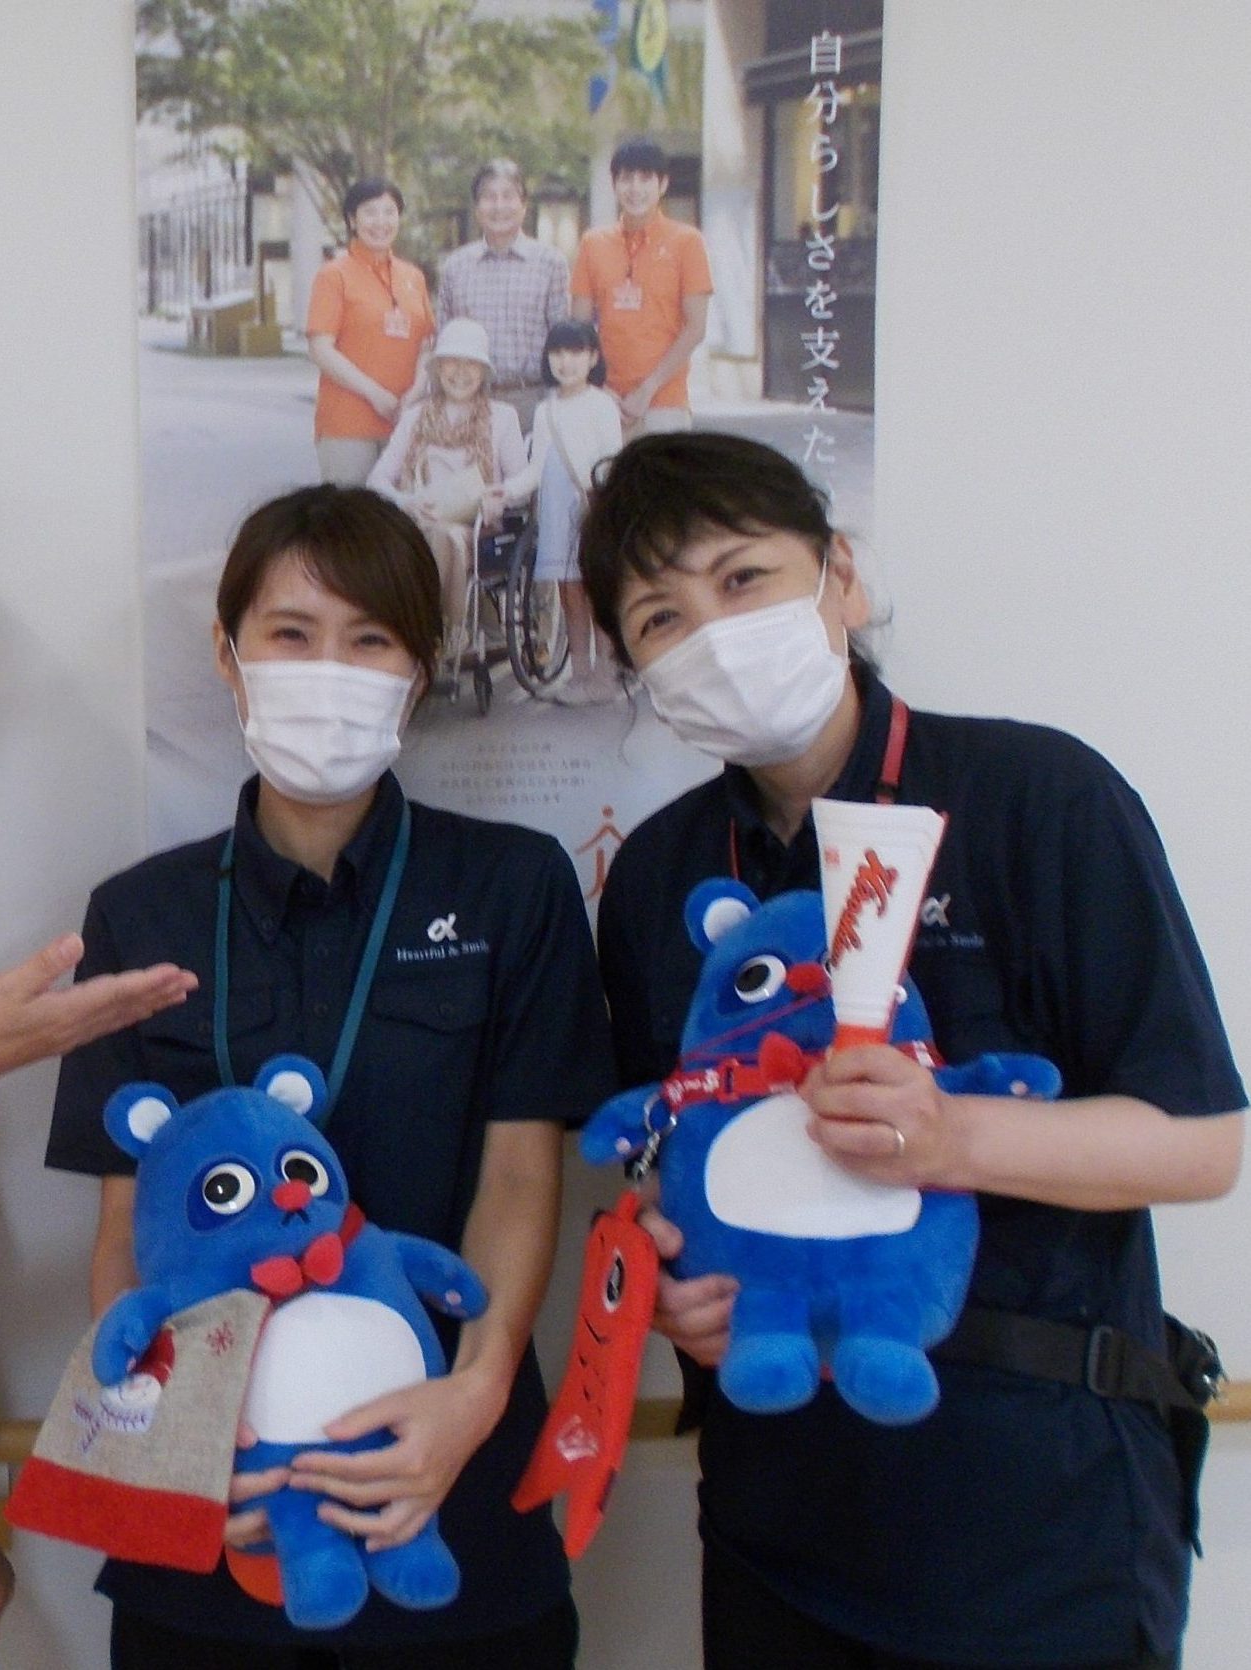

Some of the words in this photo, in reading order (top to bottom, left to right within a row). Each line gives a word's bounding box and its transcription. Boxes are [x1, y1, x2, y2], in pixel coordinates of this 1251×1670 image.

[801, 30, 843, 498] 自分らしさを支えた
